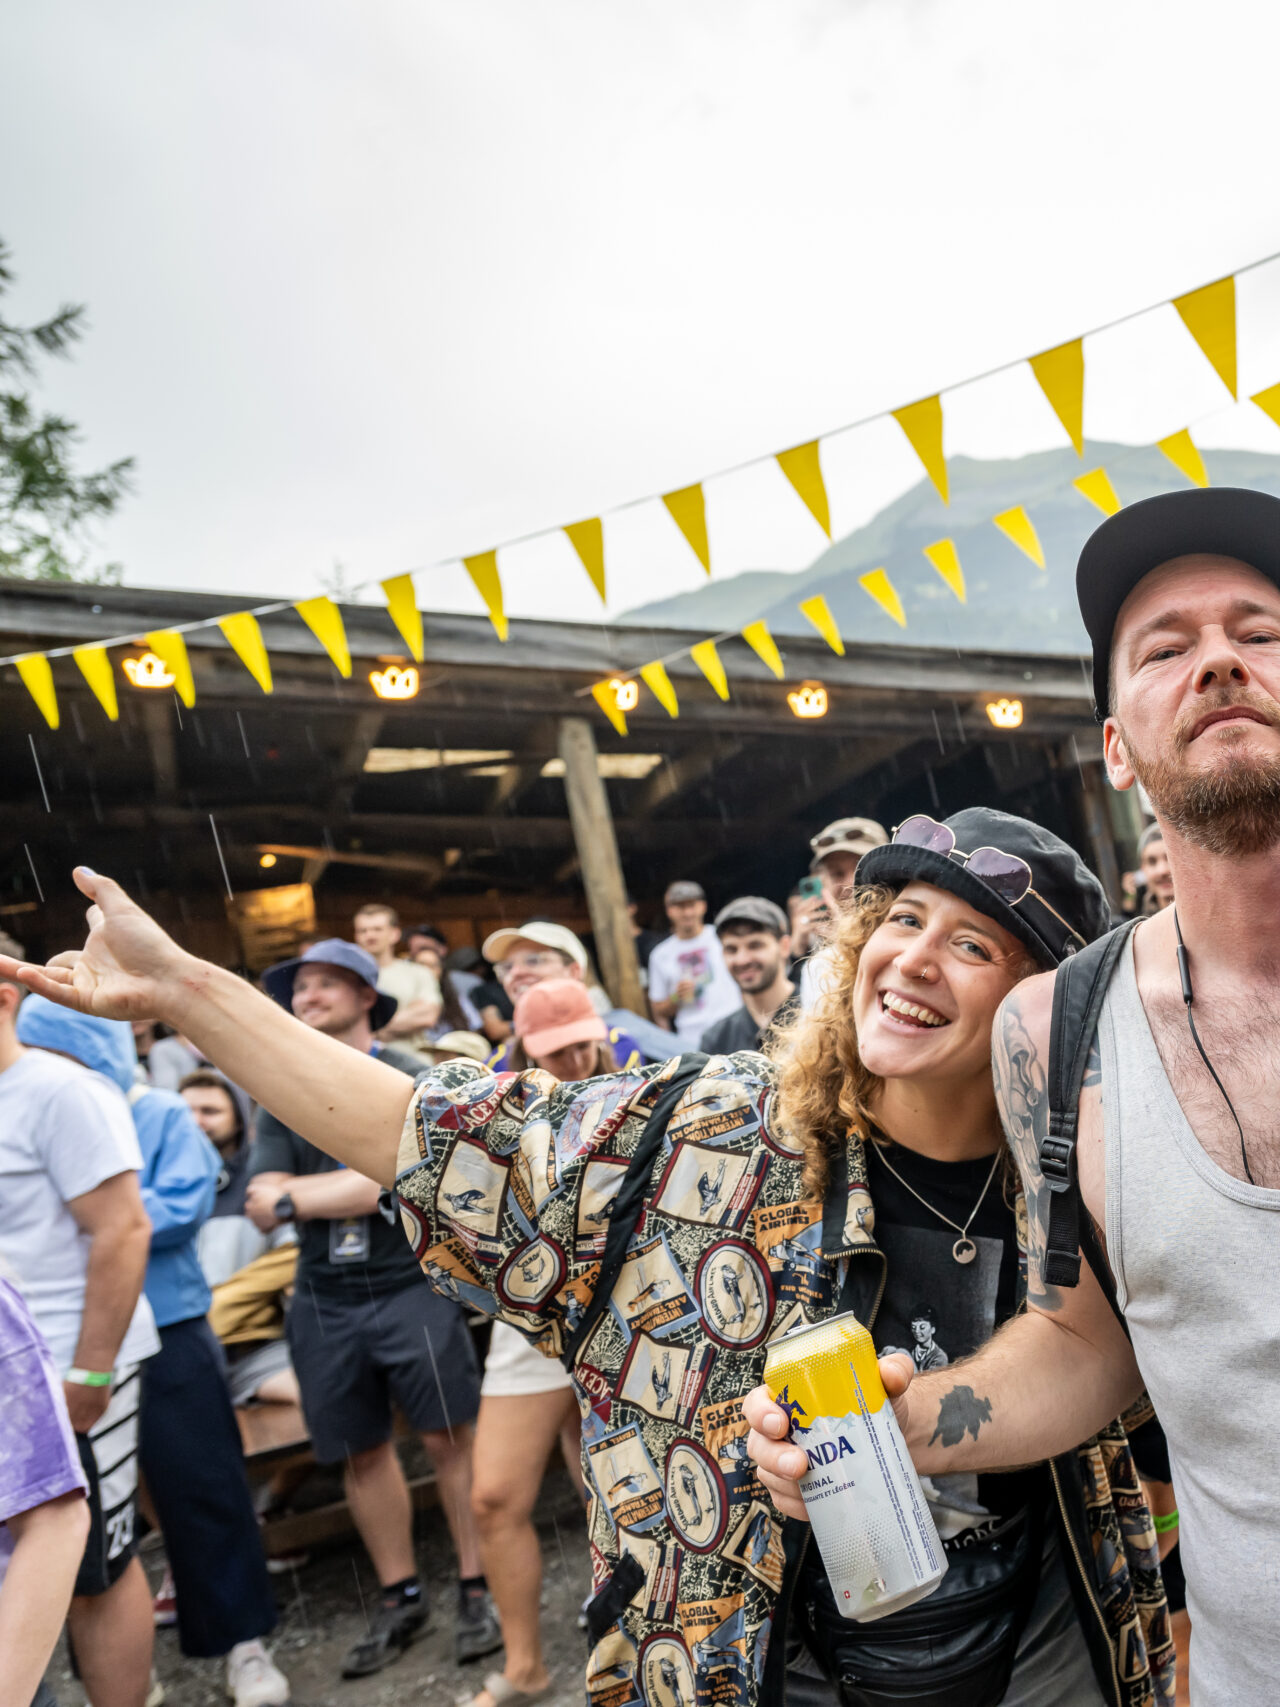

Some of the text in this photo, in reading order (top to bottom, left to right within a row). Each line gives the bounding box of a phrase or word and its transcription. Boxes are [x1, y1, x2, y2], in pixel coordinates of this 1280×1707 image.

[461, 1102, 493, 1133] ACE
[591, 1119, 616, 1153] ACE
[586, 1372, 614, 1401] ACE
[706, 1402, 744, 1422] GLOB
[806, 1435, 856, 1471] NDA
